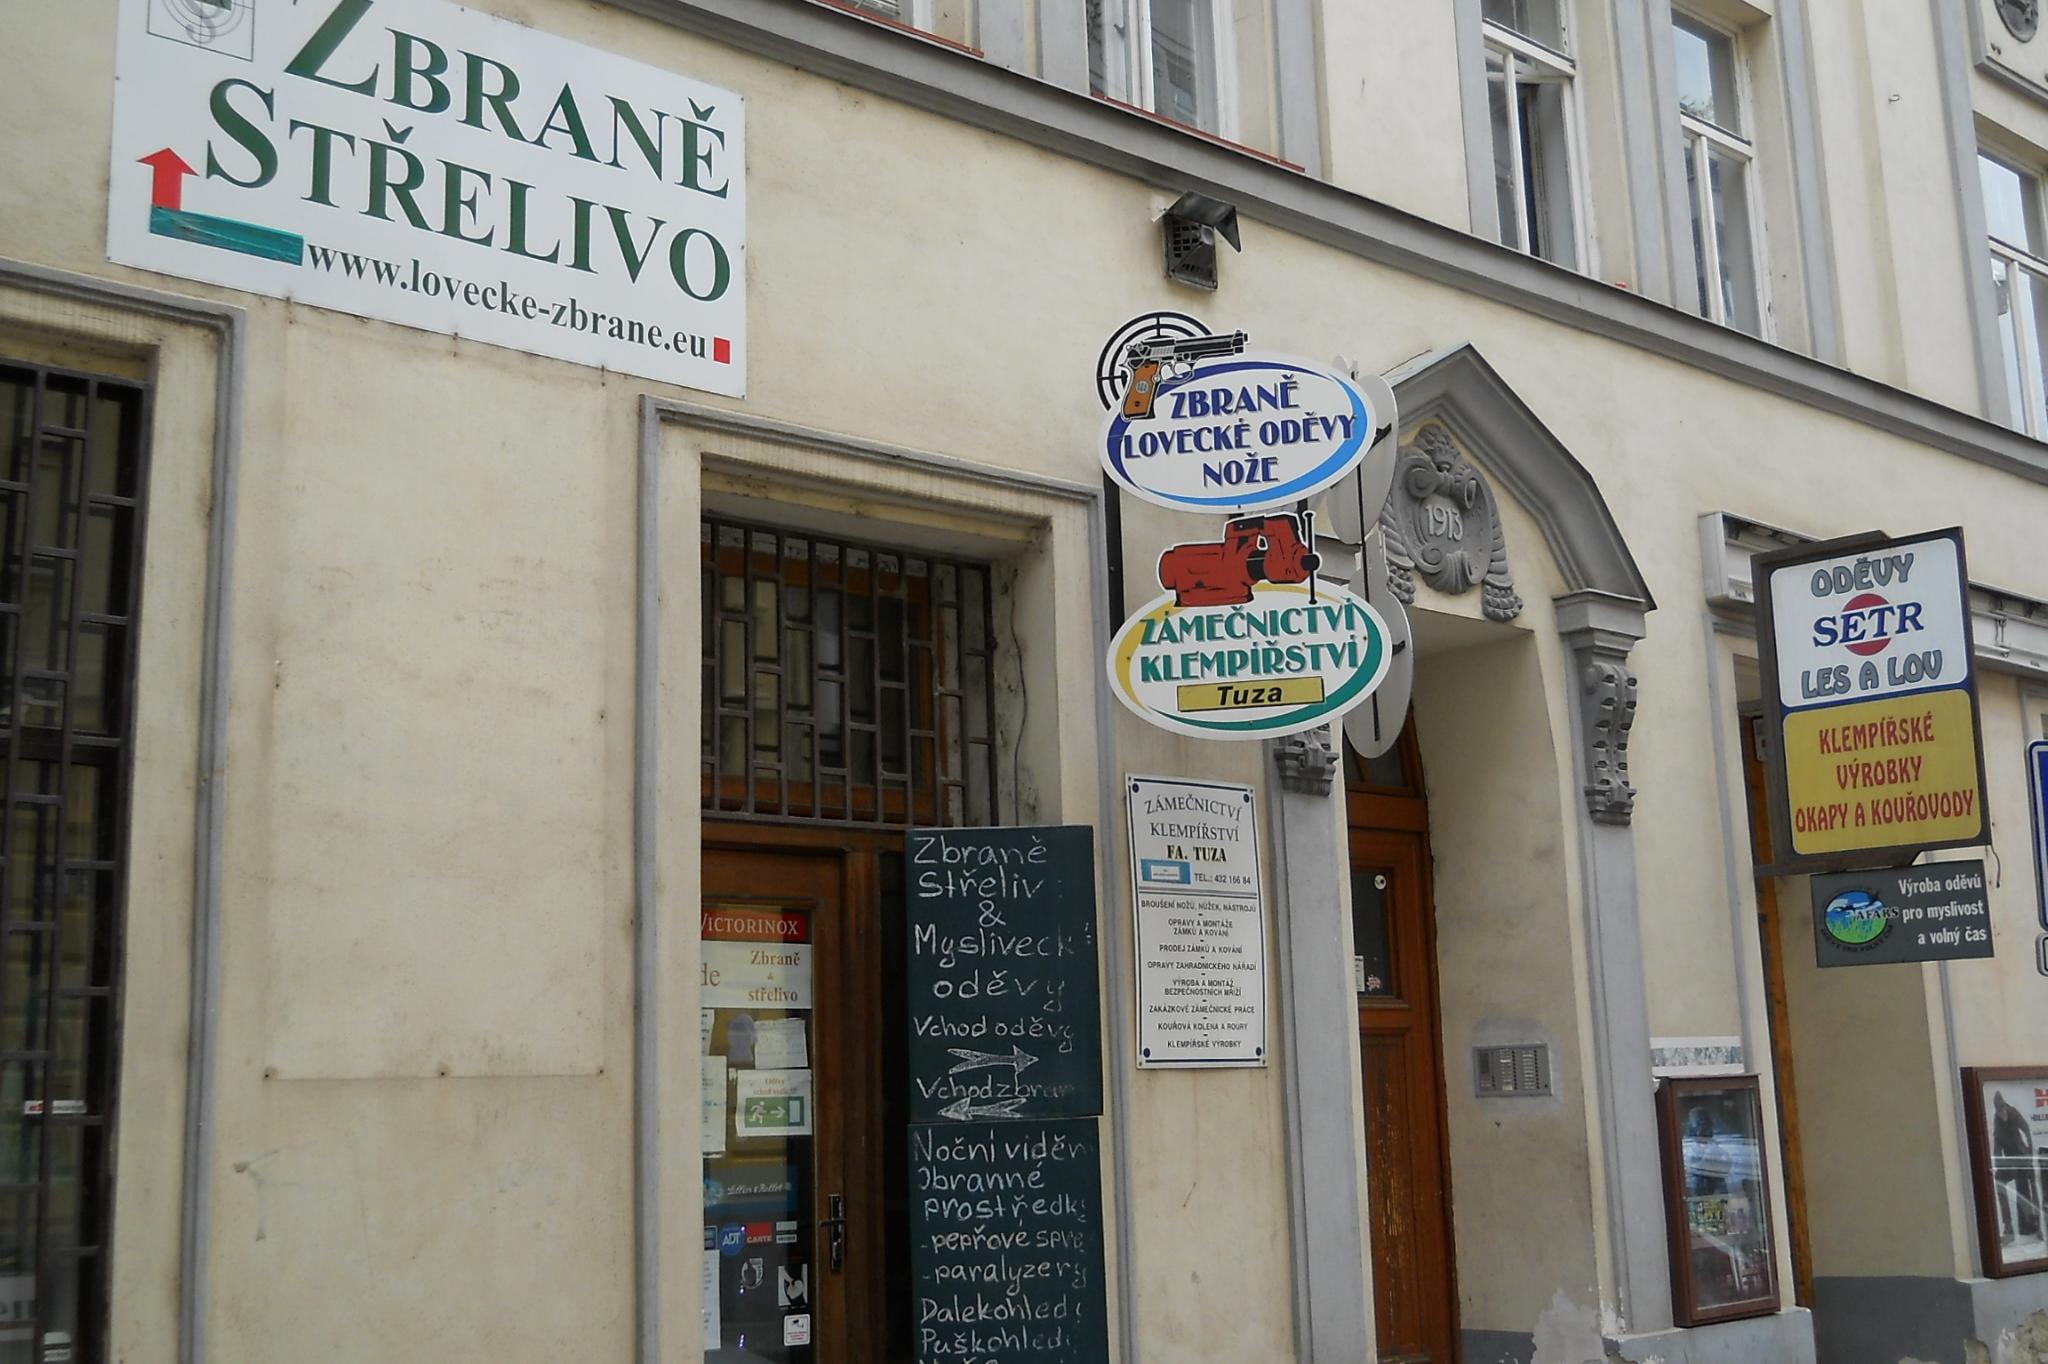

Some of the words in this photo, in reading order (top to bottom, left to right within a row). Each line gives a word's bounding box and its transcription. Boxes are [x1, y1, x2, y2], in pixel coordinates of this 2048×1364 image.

[284, 0, 730, 200] ZBRANĚ
[206, 78, 732, 303] STŘELIVO
[307, 242, 707, 361] www.lovecke-zbrane.eu
[1169, 374, 1300, 420] ZBRANĚ
[1123, 418, 1251, 459] LOVECKÉ
[1258, 411, 1358, 448] ODĚVY
[1202, 452, 1279, 488] NOŽE
[1425, 503, 1464, 541] 1913
[1811, 552, 1914, 598] ODĚVY
[1139, 597, 1357, 648] ZÁMEČNICTVÍ
[1812, 601, 1924, 648] SETR
[1140, 635, 1360, 684] KLEMPÍŘSTVÍ
[1801, 664, 1851, 699] LES
[1858, 660, 1880, 691] A
[1887, 649, 1942, 687] LOV
[1217, 682, 1282, 707] Tuza
[1819, 711, 1935, 755] KLEMPÍŘSKÉ
[1836, 755, 1922, 790] VÝROBKY
[1144, 794, 1242, 822] ZÁMEČNICTVÍ
[1795, 801, 1848, 833] OKAPY
[1854, 801, 1866, 827] A
[1871, 788, 1974, 825] KOUŘOVODY
[1150, 822, 1240, 842] KLEMPÍŘSTVÍ
[913, 835, 1048, 865] Zbraně
[1167, 844, 1188, 860] FA.
[1193, 846, 1227, 862] TUZA
[918, 865, 1063, 899] Střeliv
[1214, 874, 1227, 883] 432
[1242, 877, 1251, 885] 84
[1898, 877, 1941, 898] Výroba
[1945, 873, 1982, 892] oděvů
[978, 899, 1006, 928] &
[1141, 899, 1175, 909] BROUŠENÍ
[1903, 907, 1923, 924] pro
[1927, 899, 1984, 922] myslivost
[1168, 918, 1195, 927] OPRAVY
[1203, 919, 1233, 929] MONTÁŽE
[1917, 932, 1926, 945] a
[1929, 927, 1960, 946] volný
[1965, 926, 1987, 941] čas
[751, 950, 800, 967] Zbraně
[914, 922, 1091, 968] Mysliveck
[1159, 944, 1186, 953] PRODEJ
[1147, 961, 1175, 969] OPRAVY
[748, 986, 798, 1002] střelivo
[932, 968, 1065, 1012] oděvy
[1173, 978, 1200, 987] VÝROBA
[1234, 1005, 1255, 1013] PRÁCE
[912, 1015, 987, 1038] Vchod
[994, 1015, 1075, 1053] oděvy
[1193, 1022, 1219, 1030] KOLENA
[1227, 1022, 1248, 1031] ROURY
[1167, 1038, 1210, 1048] KLEMPÍŘSKÉ
[1212, 1038, 1242, 1048] VÝROBKY
[916, 1074, 992, 1100] Vchod
[913, 1127, 996, 1163] Noční
[722, 1231, 741, 1247] ADT
[921, 1325, 1072, 1355] Puškohled
